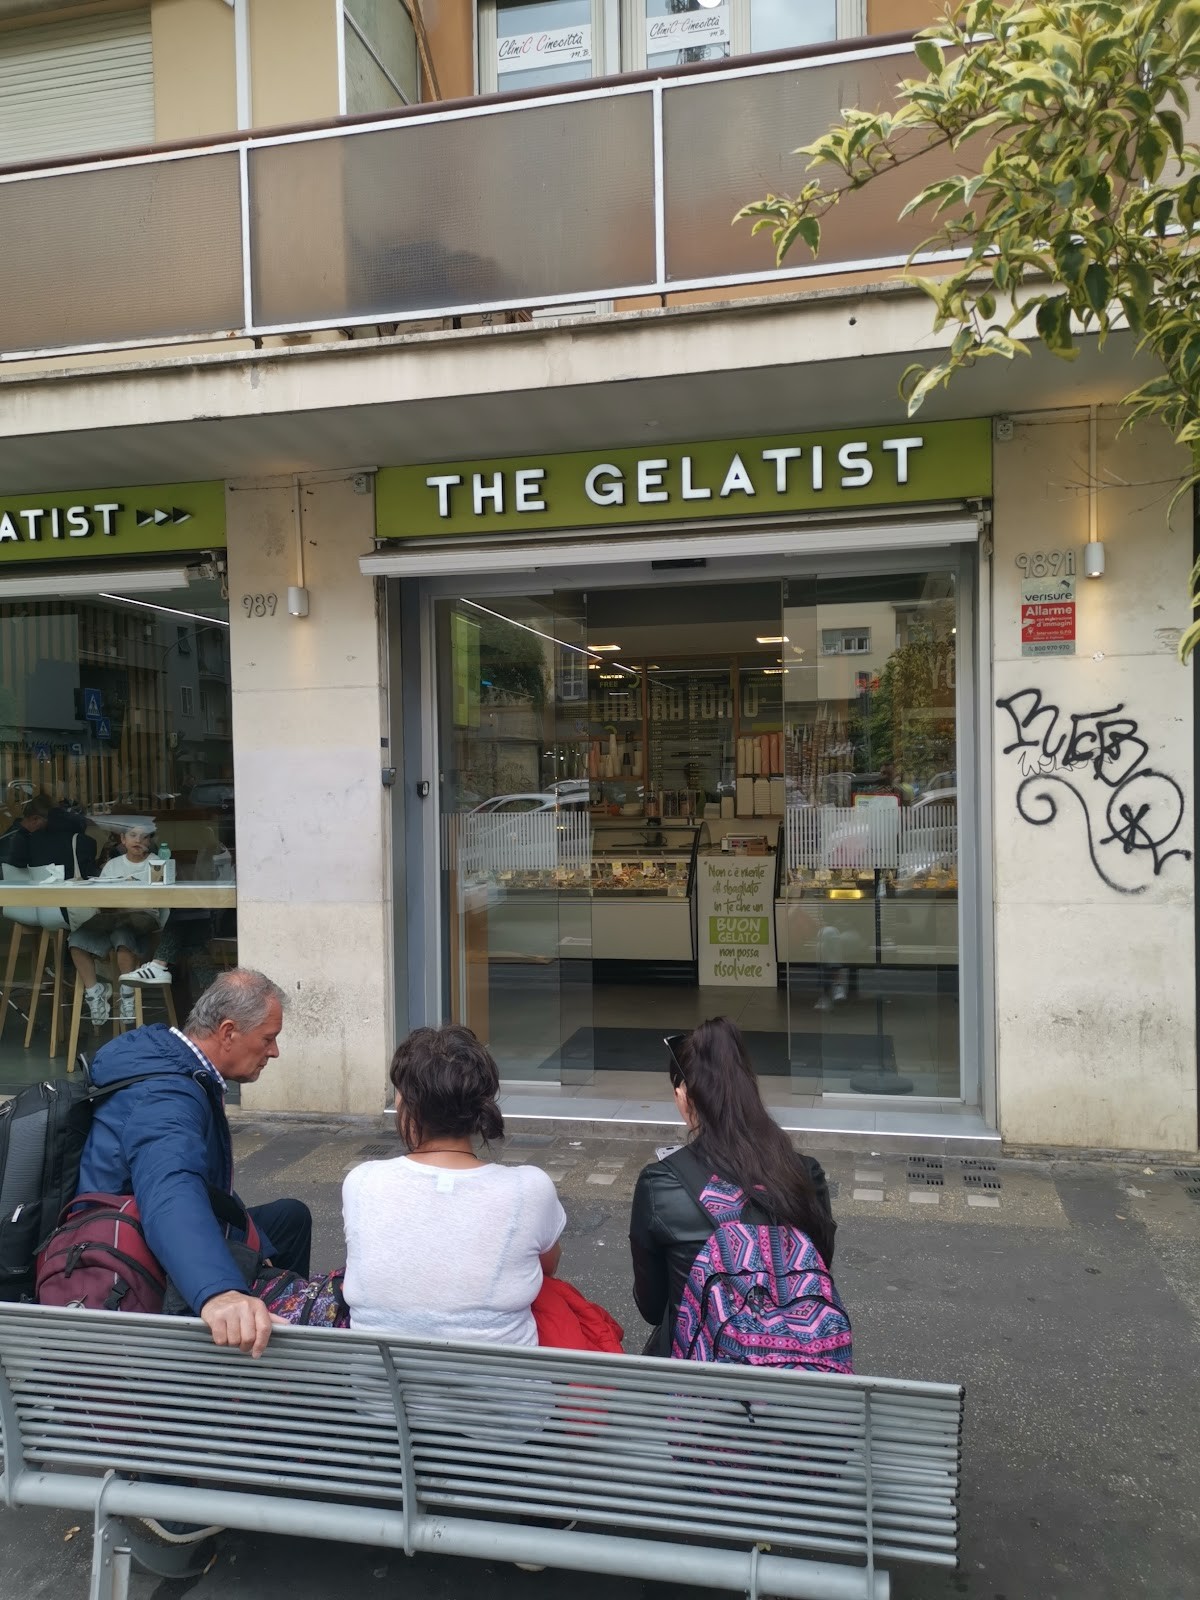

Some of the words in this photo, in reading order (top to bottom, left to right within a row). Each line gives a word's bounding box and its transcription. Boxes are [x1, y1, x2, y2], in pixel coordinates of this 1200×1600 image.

[680, 16, 721, 32] Cinecittà
[536, 31, 583, 52] Cinecittà
[426, 469, 548, 518] THE
[584, 437, 924, 506] GELATIST
[1025, 592, 1073, 602] verisure
[242, 593, 278, 618] 989
[1026, 606, 1073, 616] Allarme
[1036, 620, 1073, 628] d'immagini
[741, 865, 769, 879] niente
[723, 881, 762, 902] sbagliato
[753, 903, 764, 912] un
[716, 918, 761, 932] BUON
[718, 932, 761, 944] GELATO
[719, 948, 735, 958] non
[737, 948, 760, 962] possa
